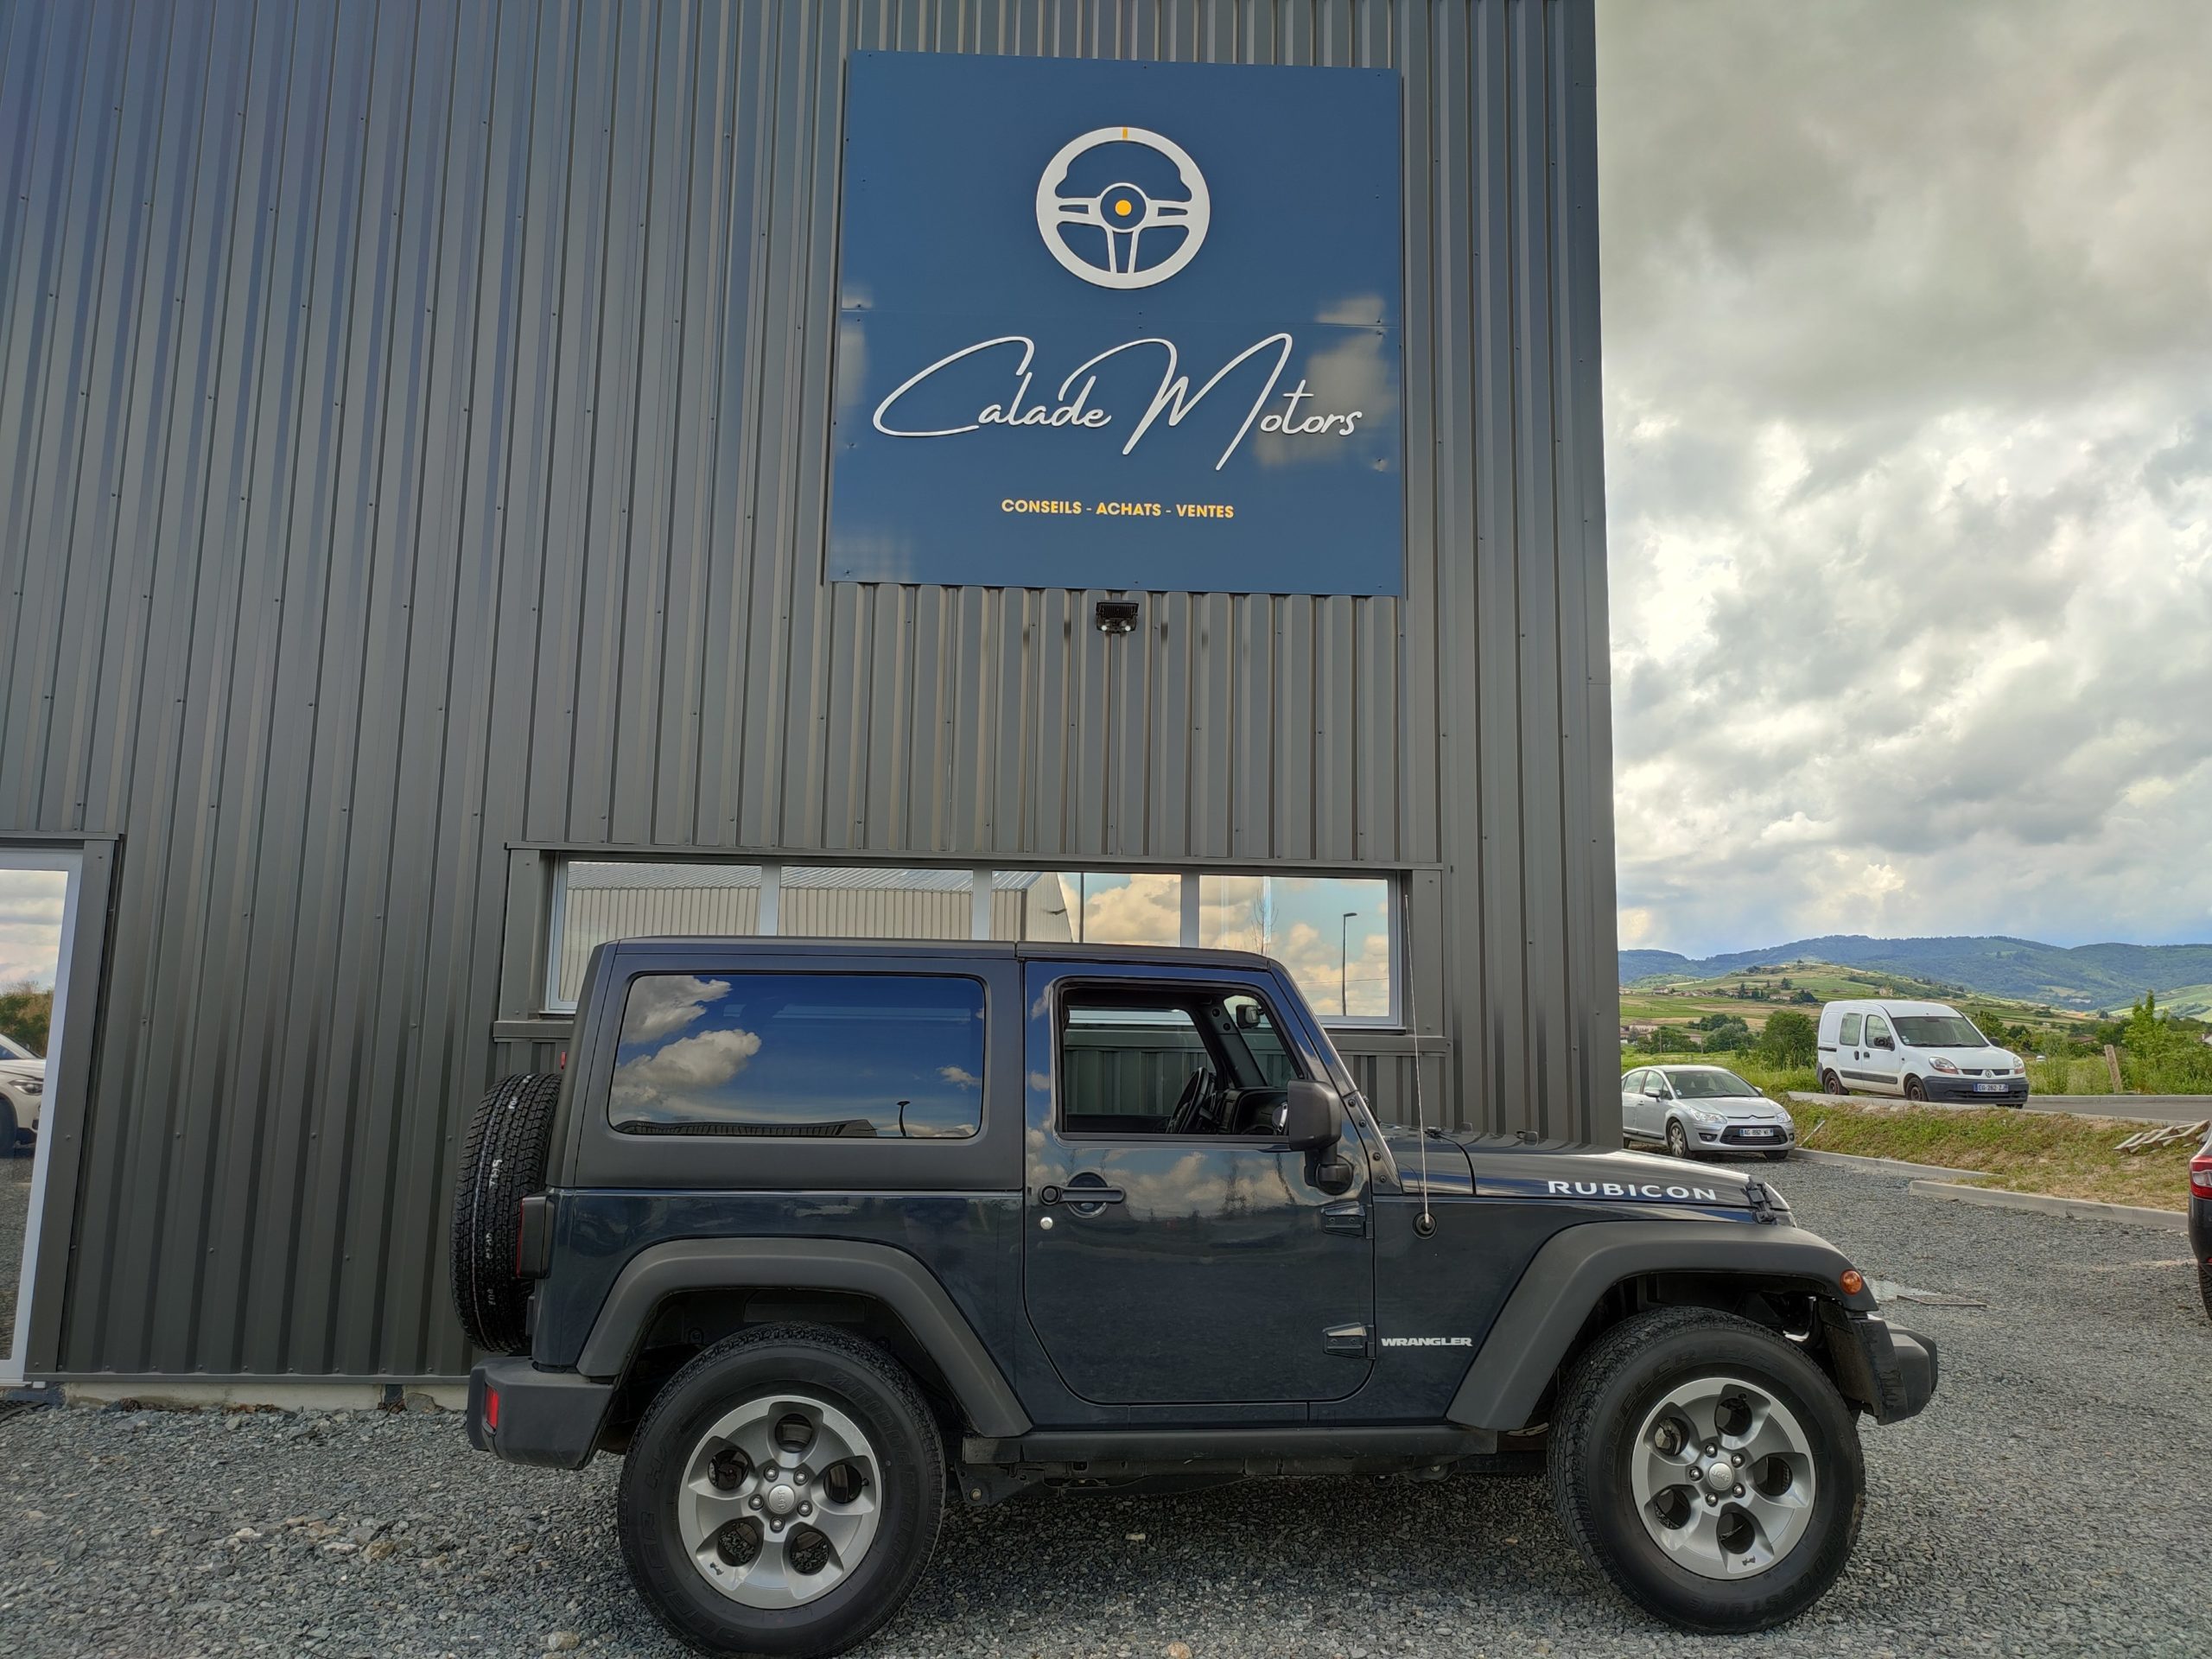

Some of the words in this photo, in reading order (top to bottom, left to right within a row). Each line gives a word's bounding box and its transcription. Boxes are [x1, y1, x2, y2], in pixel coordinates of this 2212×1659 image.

[873, 335, 1112, 437] Calade
[1058, 333, 1363, 471] Motors
[1001, 499, 1082, 515] CONSEILS
[1096, 501, 1161, 517] ACHATS
[1175, 503, 1235, 518] VENTES
[1548, 1180, 1717, 1200] RUBICON
[1381, 1337, 1473, 1347] WRANGLER
